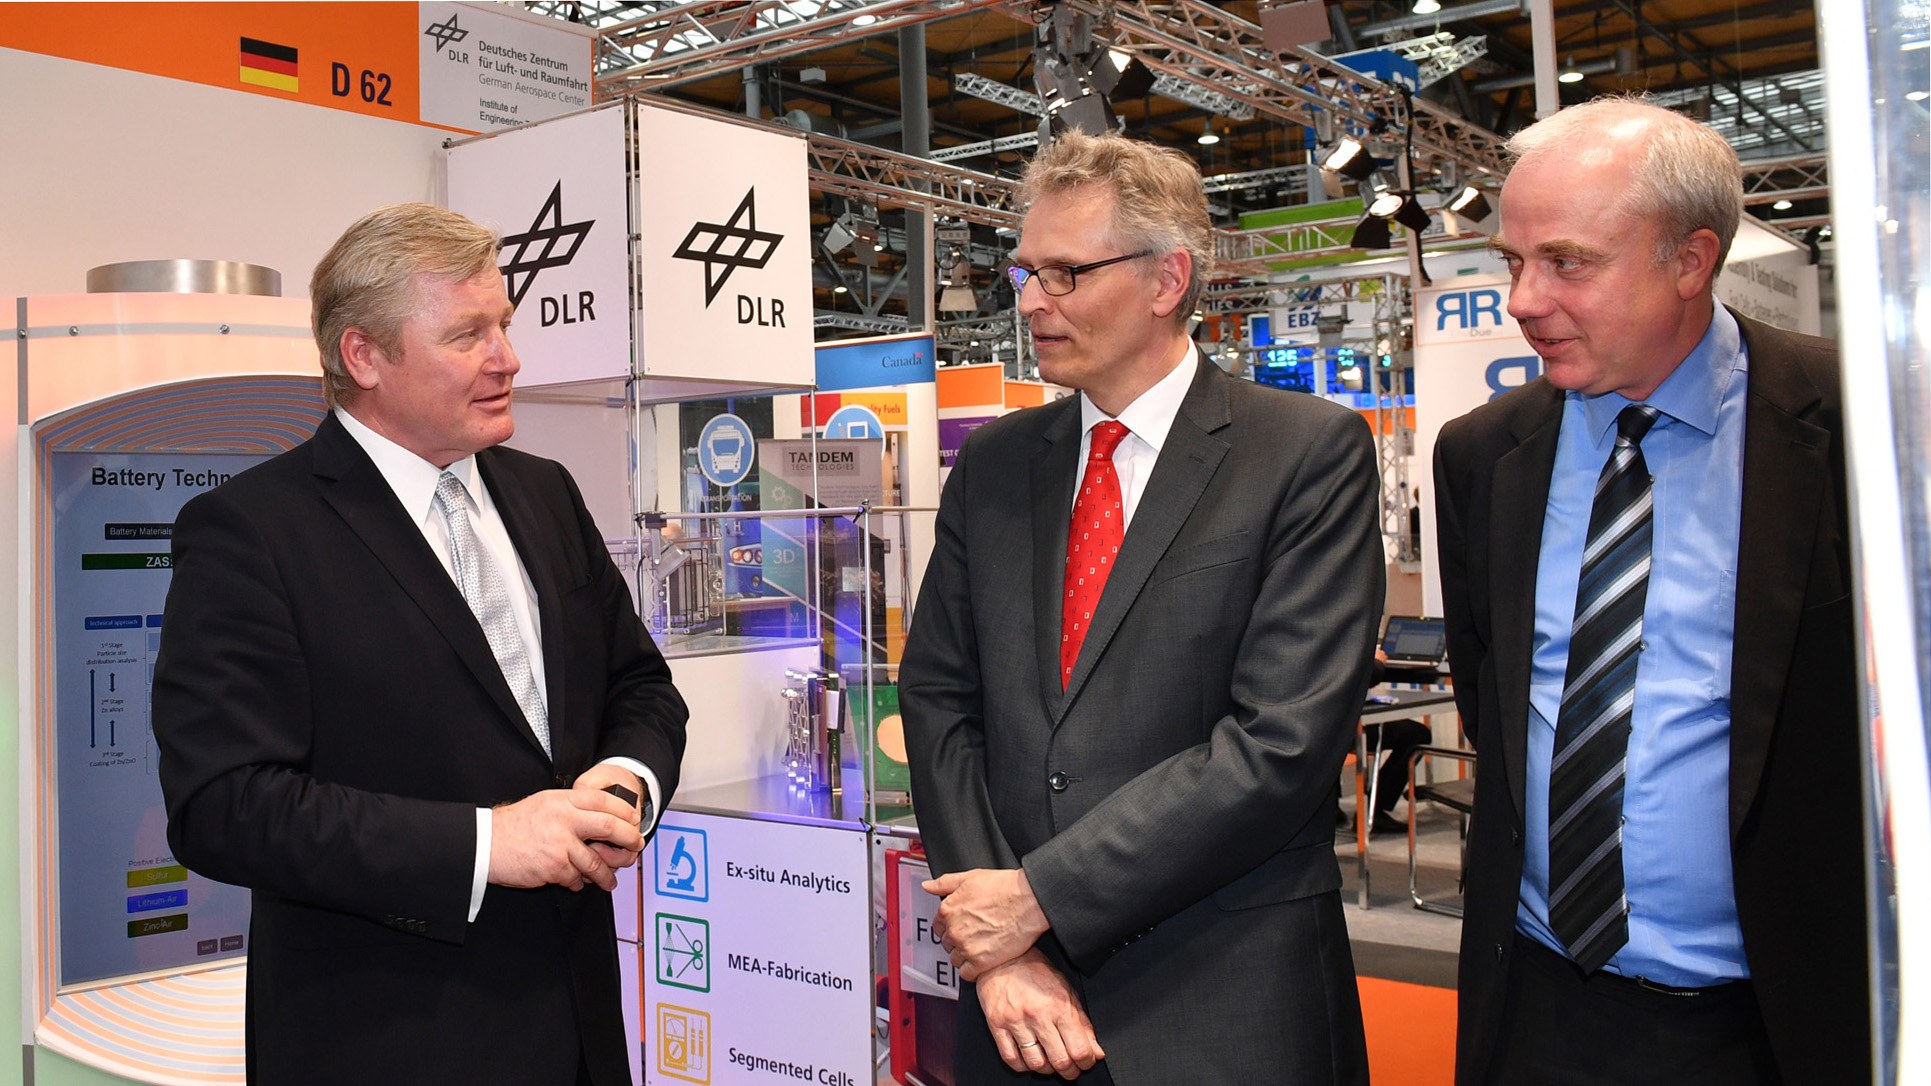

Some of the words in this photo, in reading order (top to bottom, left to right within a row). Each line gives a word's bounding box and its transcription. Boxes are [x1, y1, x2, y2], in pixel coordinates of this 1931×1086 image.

[448, 50, 469, 64] DLR
[478, 40, 527, 62] Deutsches
[530, 53, 568, 72] Zentrum
[331, 61, 350, 97] D
[360, 69, 392, 107] 62
[478, 56, 492, 70] für
[495, 60, 518, 75] Luft-
[520, 69, 538, 80] und
[540, 71, 588, 92] Raumfahrt
[478, 73, 512, 91] German
[514, 81, 557, 101] Aerospace
[558, 91, 585, 106] Center
[479, 97, 508, 112] Institute
[510, 104, 518, 114] of
[540, 290, 596, 328] DLR
[737, 294, 786, 328] DLR
[881, 353, 922, 369] Canada
[788, 451, 854, 463] TANDEM
[791, 463, 855, 471] TECHOLOGIES
[91, 467, 166, 491] Battery
[109, 526, 137, 538] Battery
[139, 526, 172, 536] Materials
[773, 548, 796, 564] 3D
[726, 861, 775, 883] Ex-situ
[780, 869, 851, 894] Analytics
[727, 953, 853, 991] MEA-Fabrication
[729, 1047, 813, 1081] Segmented
[818, 1068, 854, 1086] Cells
